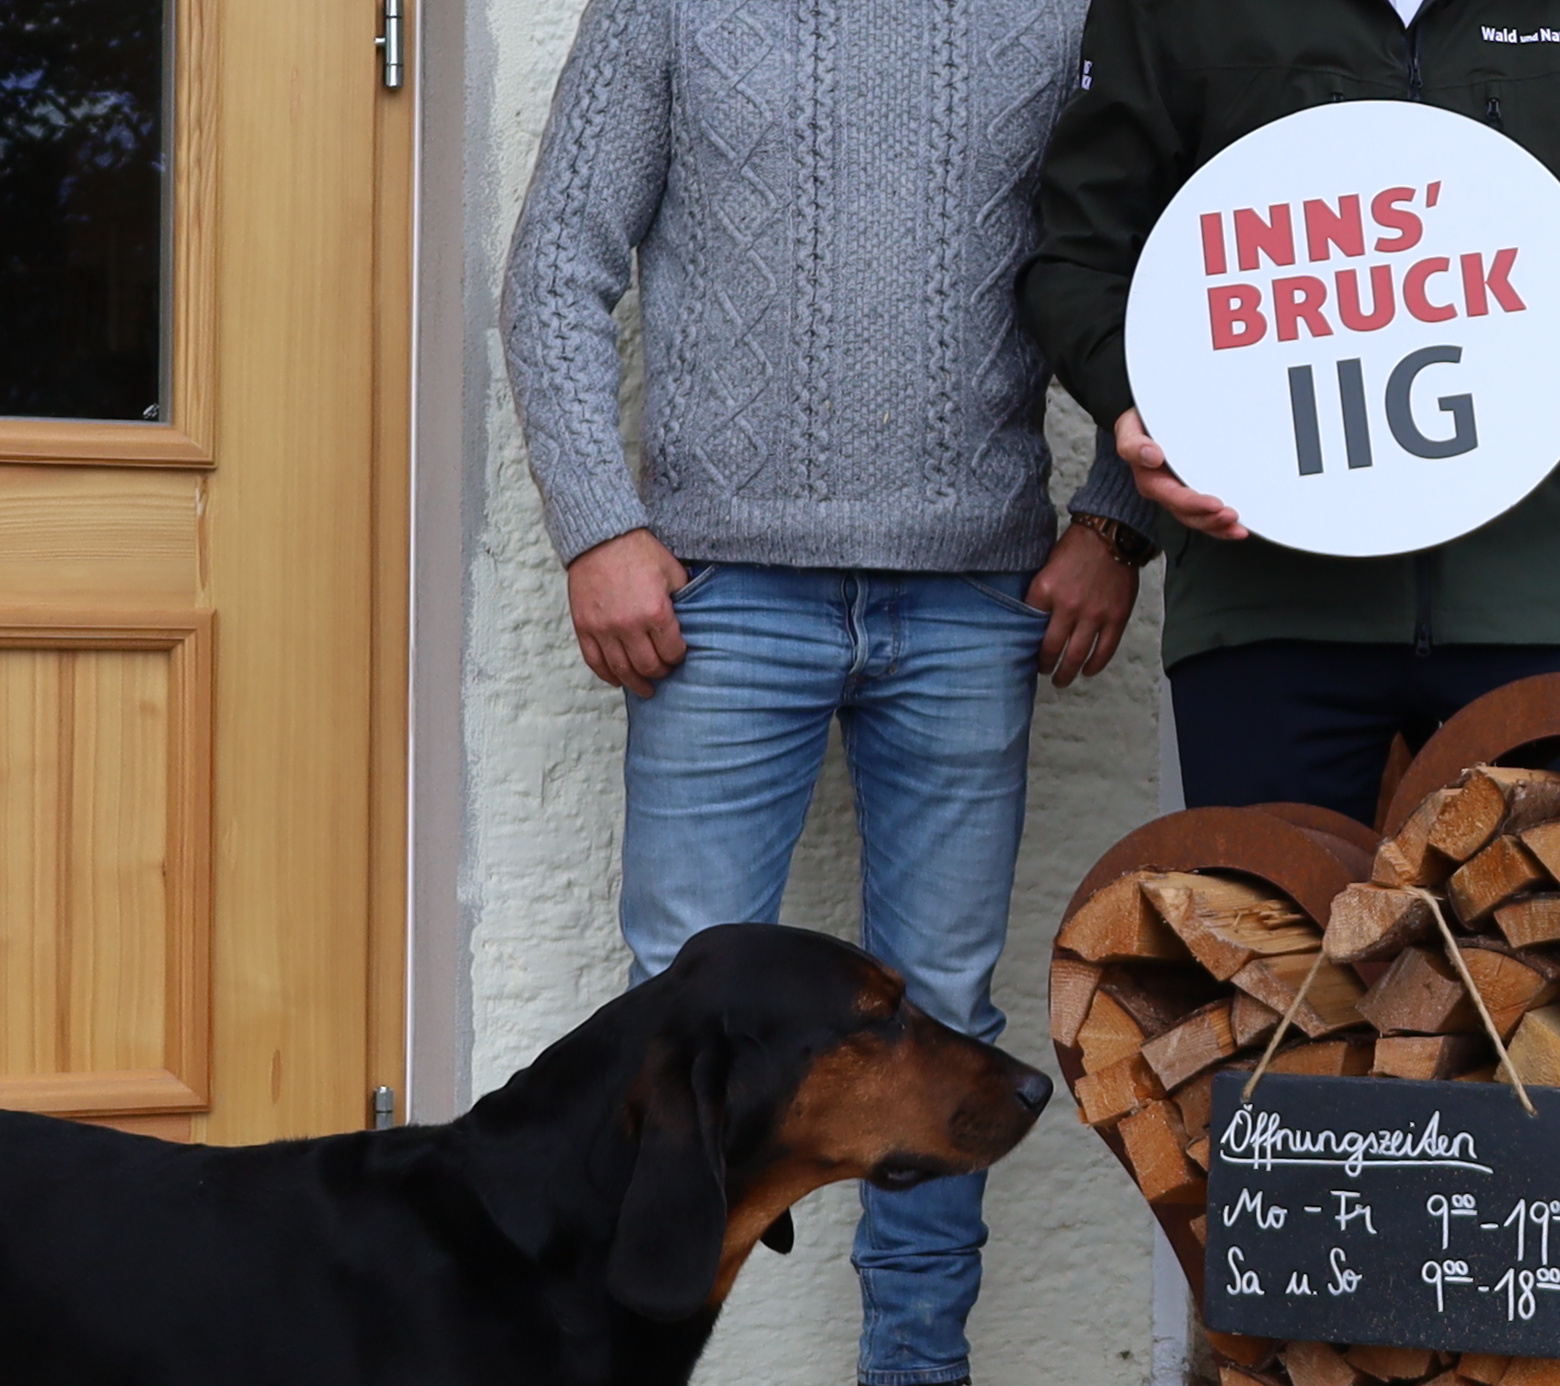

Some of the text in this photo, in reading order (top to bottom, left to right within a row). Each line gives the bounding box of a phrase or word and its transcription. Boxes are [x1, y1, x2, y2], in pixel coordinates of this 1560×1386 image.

[1481, 24, 1518, 44] Wald
[1207, 247, 1527, 351] BRUCK
[1287, 345, 1479, 477] IIG
[1221, 1103, 1478, 1177] Öffnungszeiten
[1223, 1188, 1288, 1229] Mo
[1331, 1190, 1378, 1235] Fr
[1226, 1246, 1265, 1295] Sa
[1285, 1270, 1318, 1296] u.
[1327, 1247, 1363, 1296] So
